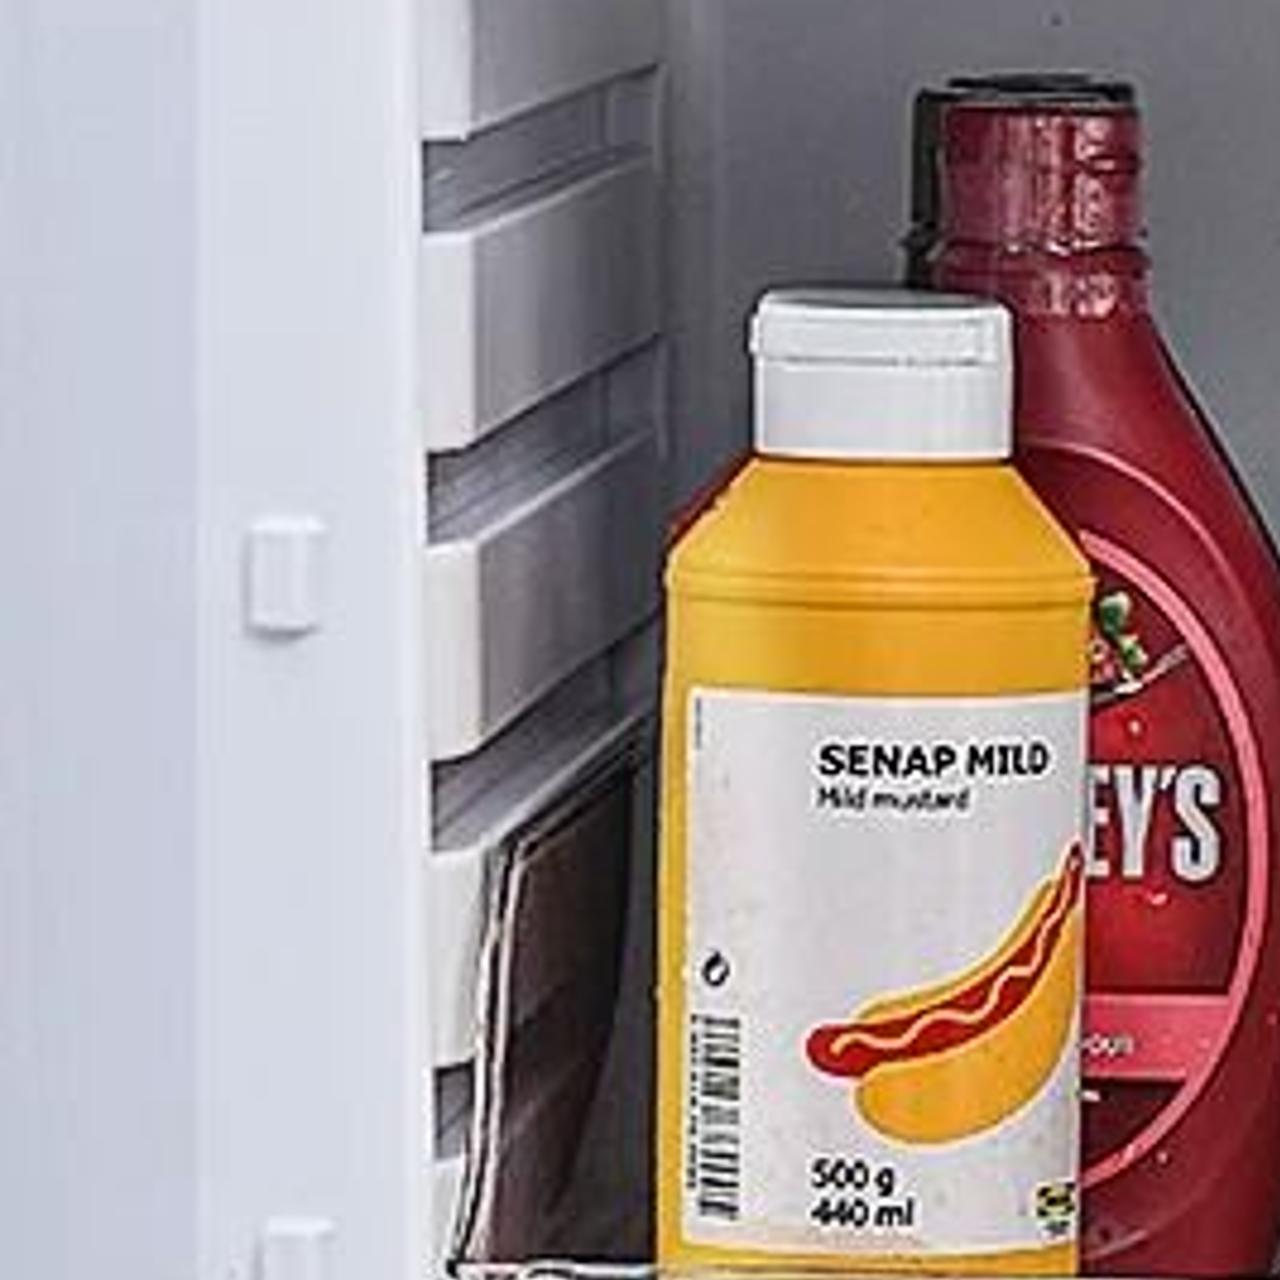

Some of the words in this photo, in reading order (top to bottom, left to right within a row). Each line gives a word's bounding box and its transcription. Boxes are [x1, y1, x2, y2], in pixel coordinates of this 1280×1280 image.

[818, 743, 957, 777] SENAP
[967, 742, 1050, 776] MILD
[817, 786, 866, 811] Mild
[873, 787, 971, 811] mustard
[810, 1157, 870, 1190] 500
[874, 1166, 895, 1197] g
[810, 1197, 870, 1228] 440
[874, 1197, 914, 1227] ml
